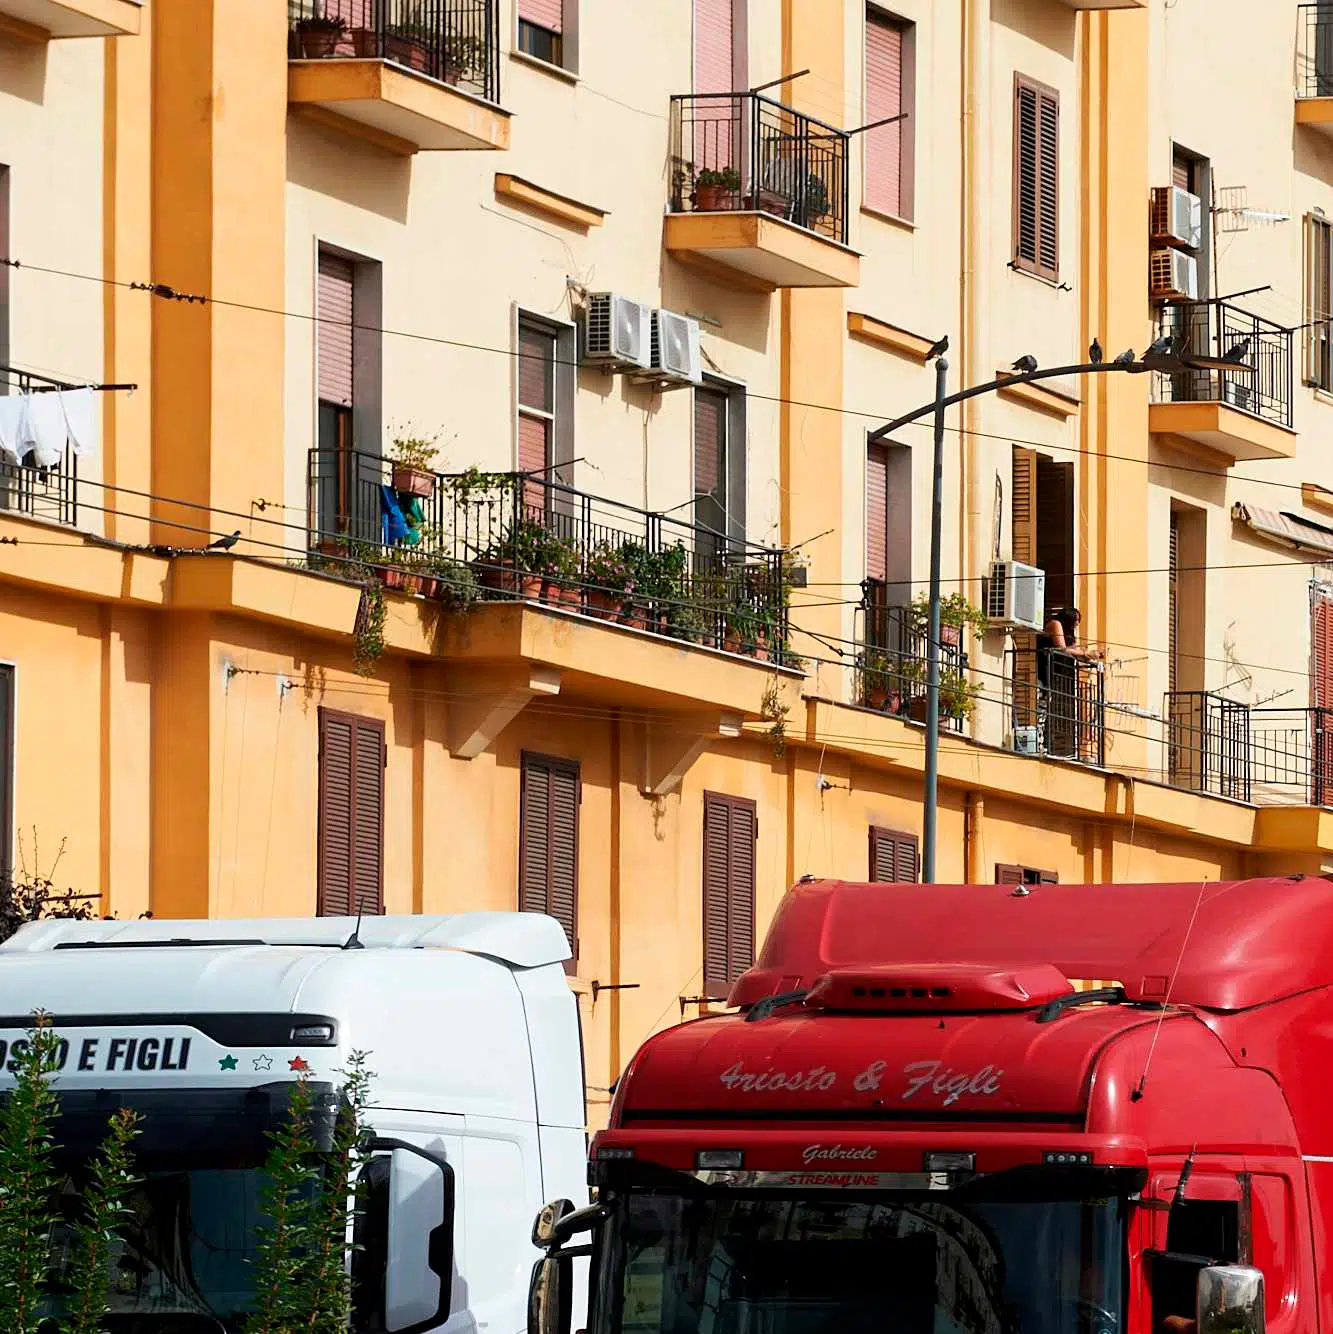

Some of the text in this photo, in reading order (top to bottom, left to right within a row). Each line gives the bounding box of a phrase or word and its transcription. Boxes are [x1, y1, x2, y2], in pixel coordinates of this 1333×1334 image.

[77, 1038, 100, 1071] E
[105, 1037, 192, 1071] FIGLI
[853, 1060, 887, 1091] &
[902, 1060, 1005, 1106] Figli
[802, 1144, 879, 1165] Gabriele
[788, 1174, 880, 1188] STREAMLINE
